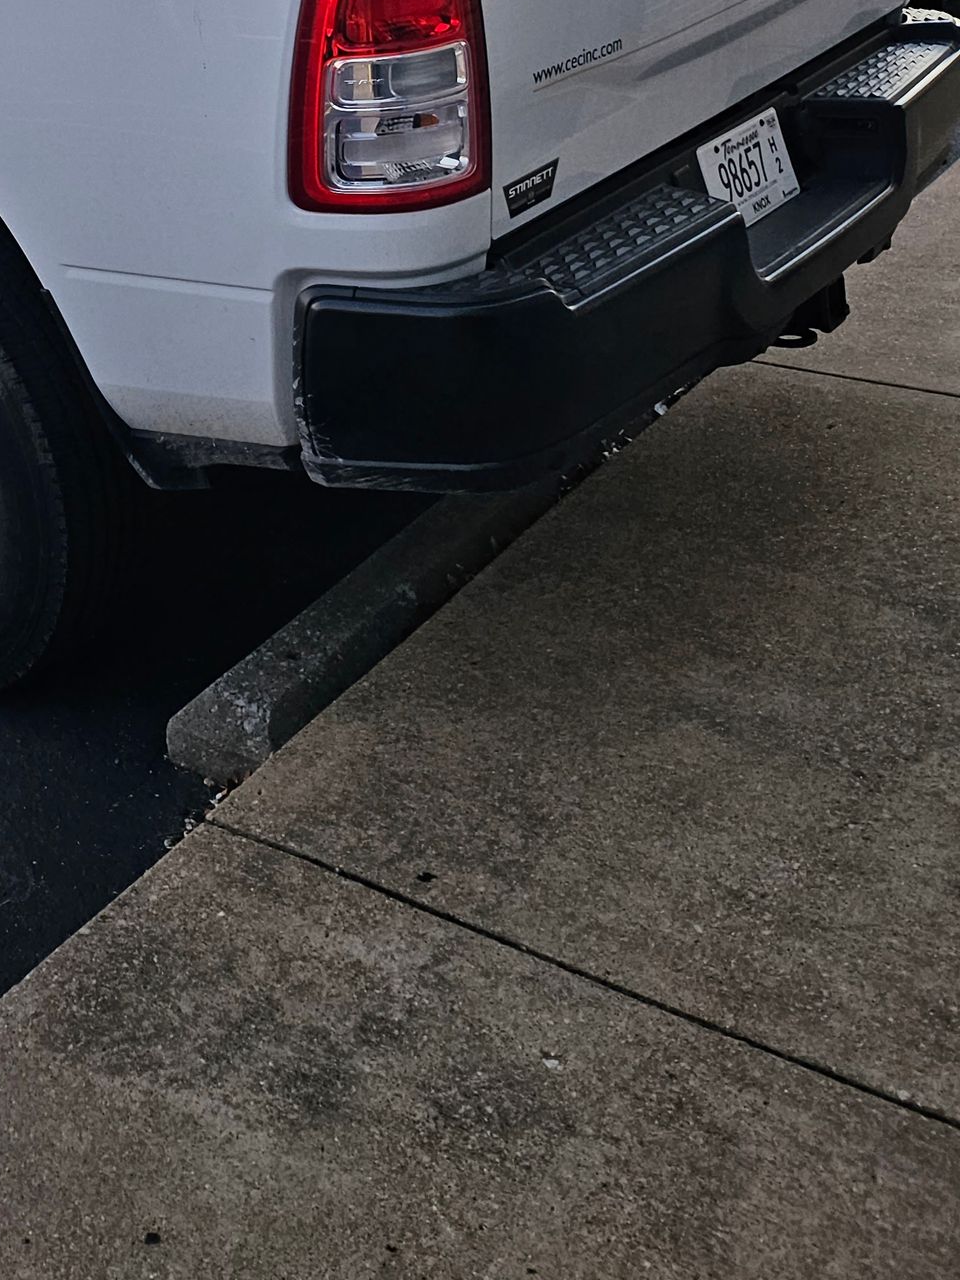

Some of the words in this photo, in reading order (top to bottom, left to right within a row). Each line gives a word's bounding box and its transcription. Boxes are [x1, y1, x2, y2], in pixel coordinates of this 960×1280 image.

[532, 37, 623, 85] www.cecinc.com
[768, 135, 778, 154] H
[718, 141, 768, 203] 98657
[775, 156, 784, 174] 2
[752, 194, 772, 214] KNOX
